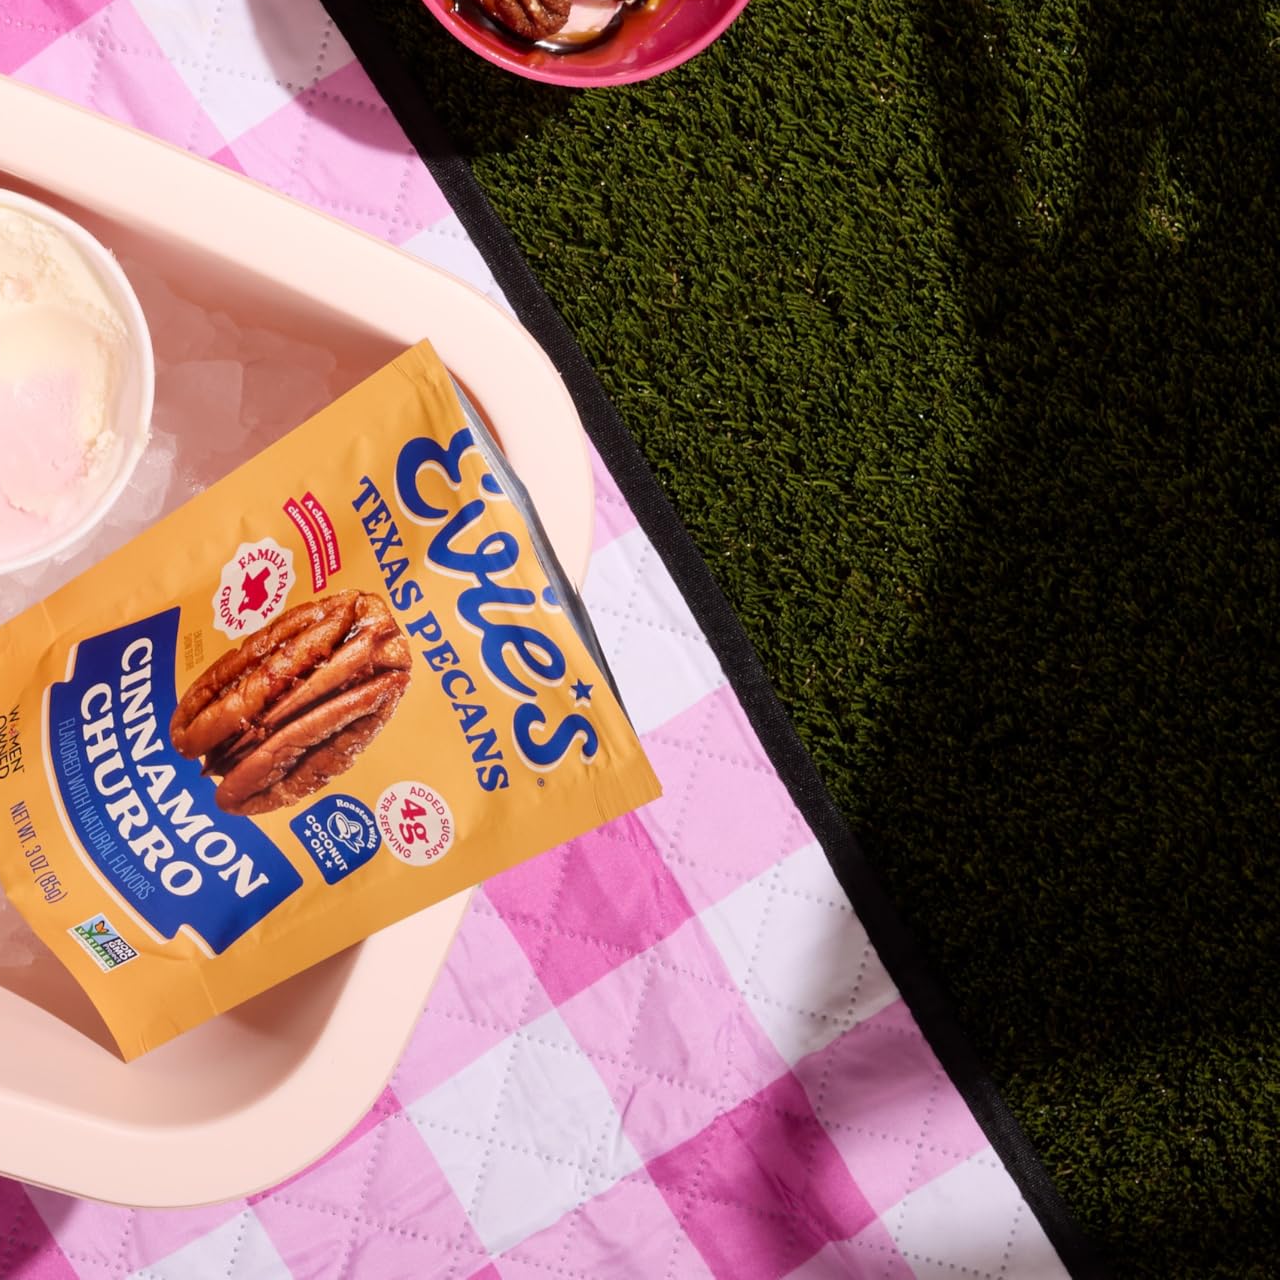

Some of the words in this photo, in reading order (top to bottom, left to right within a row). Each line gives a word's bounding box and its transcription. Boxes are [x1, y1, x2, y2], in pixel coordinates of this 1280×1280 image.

[287, 505, 317, 554] cinnamon
[304, 499, 314, 510] A
[311, 508, 332, 541] classic
[326, 540, 338, 571] sweet
[238, 548, 287, 570] FAMILY
[220, 586, 246, 630] GROWN
[261, 571, 288, 619] FARM
[351, 475, 424, 611] TEXAS
[405, 609, 510, 792] PECANS
[58, 717, 81, 777] FLAVORED
[120, 637, 269, 898] CINNAMON
[69, 772, 90, 809] WITH
[80, 682, 203, 896] CHURRO
[380, 792, 398, 812] PER
[409, 786, 445, 816] ADDED
[9, 800, 29, 826] NET
[16, 821, 38, 848] WT.
[78, 804, 116, 861] NATURAL
[335, 798, 371, 826] Roasted
[366, 824, 378, 849] with
[399, 798, 429, 844] 4g
[24, 845, 42, 858] 3
[305, 814, 348, 871] COCONUT
[310, 838, 326, 860] OIL
[379, 813, 412, 859] SERVING
[425, 818, 450, 860] SUGARS
[34, 871, 68, 904] (85g)
[108, 853, 156, 901] FLAVORS
[77, 928, 115, 967] VERIFIED
[108, 941, 128, 960] GMO
[115, 938, 135, 957] NON
